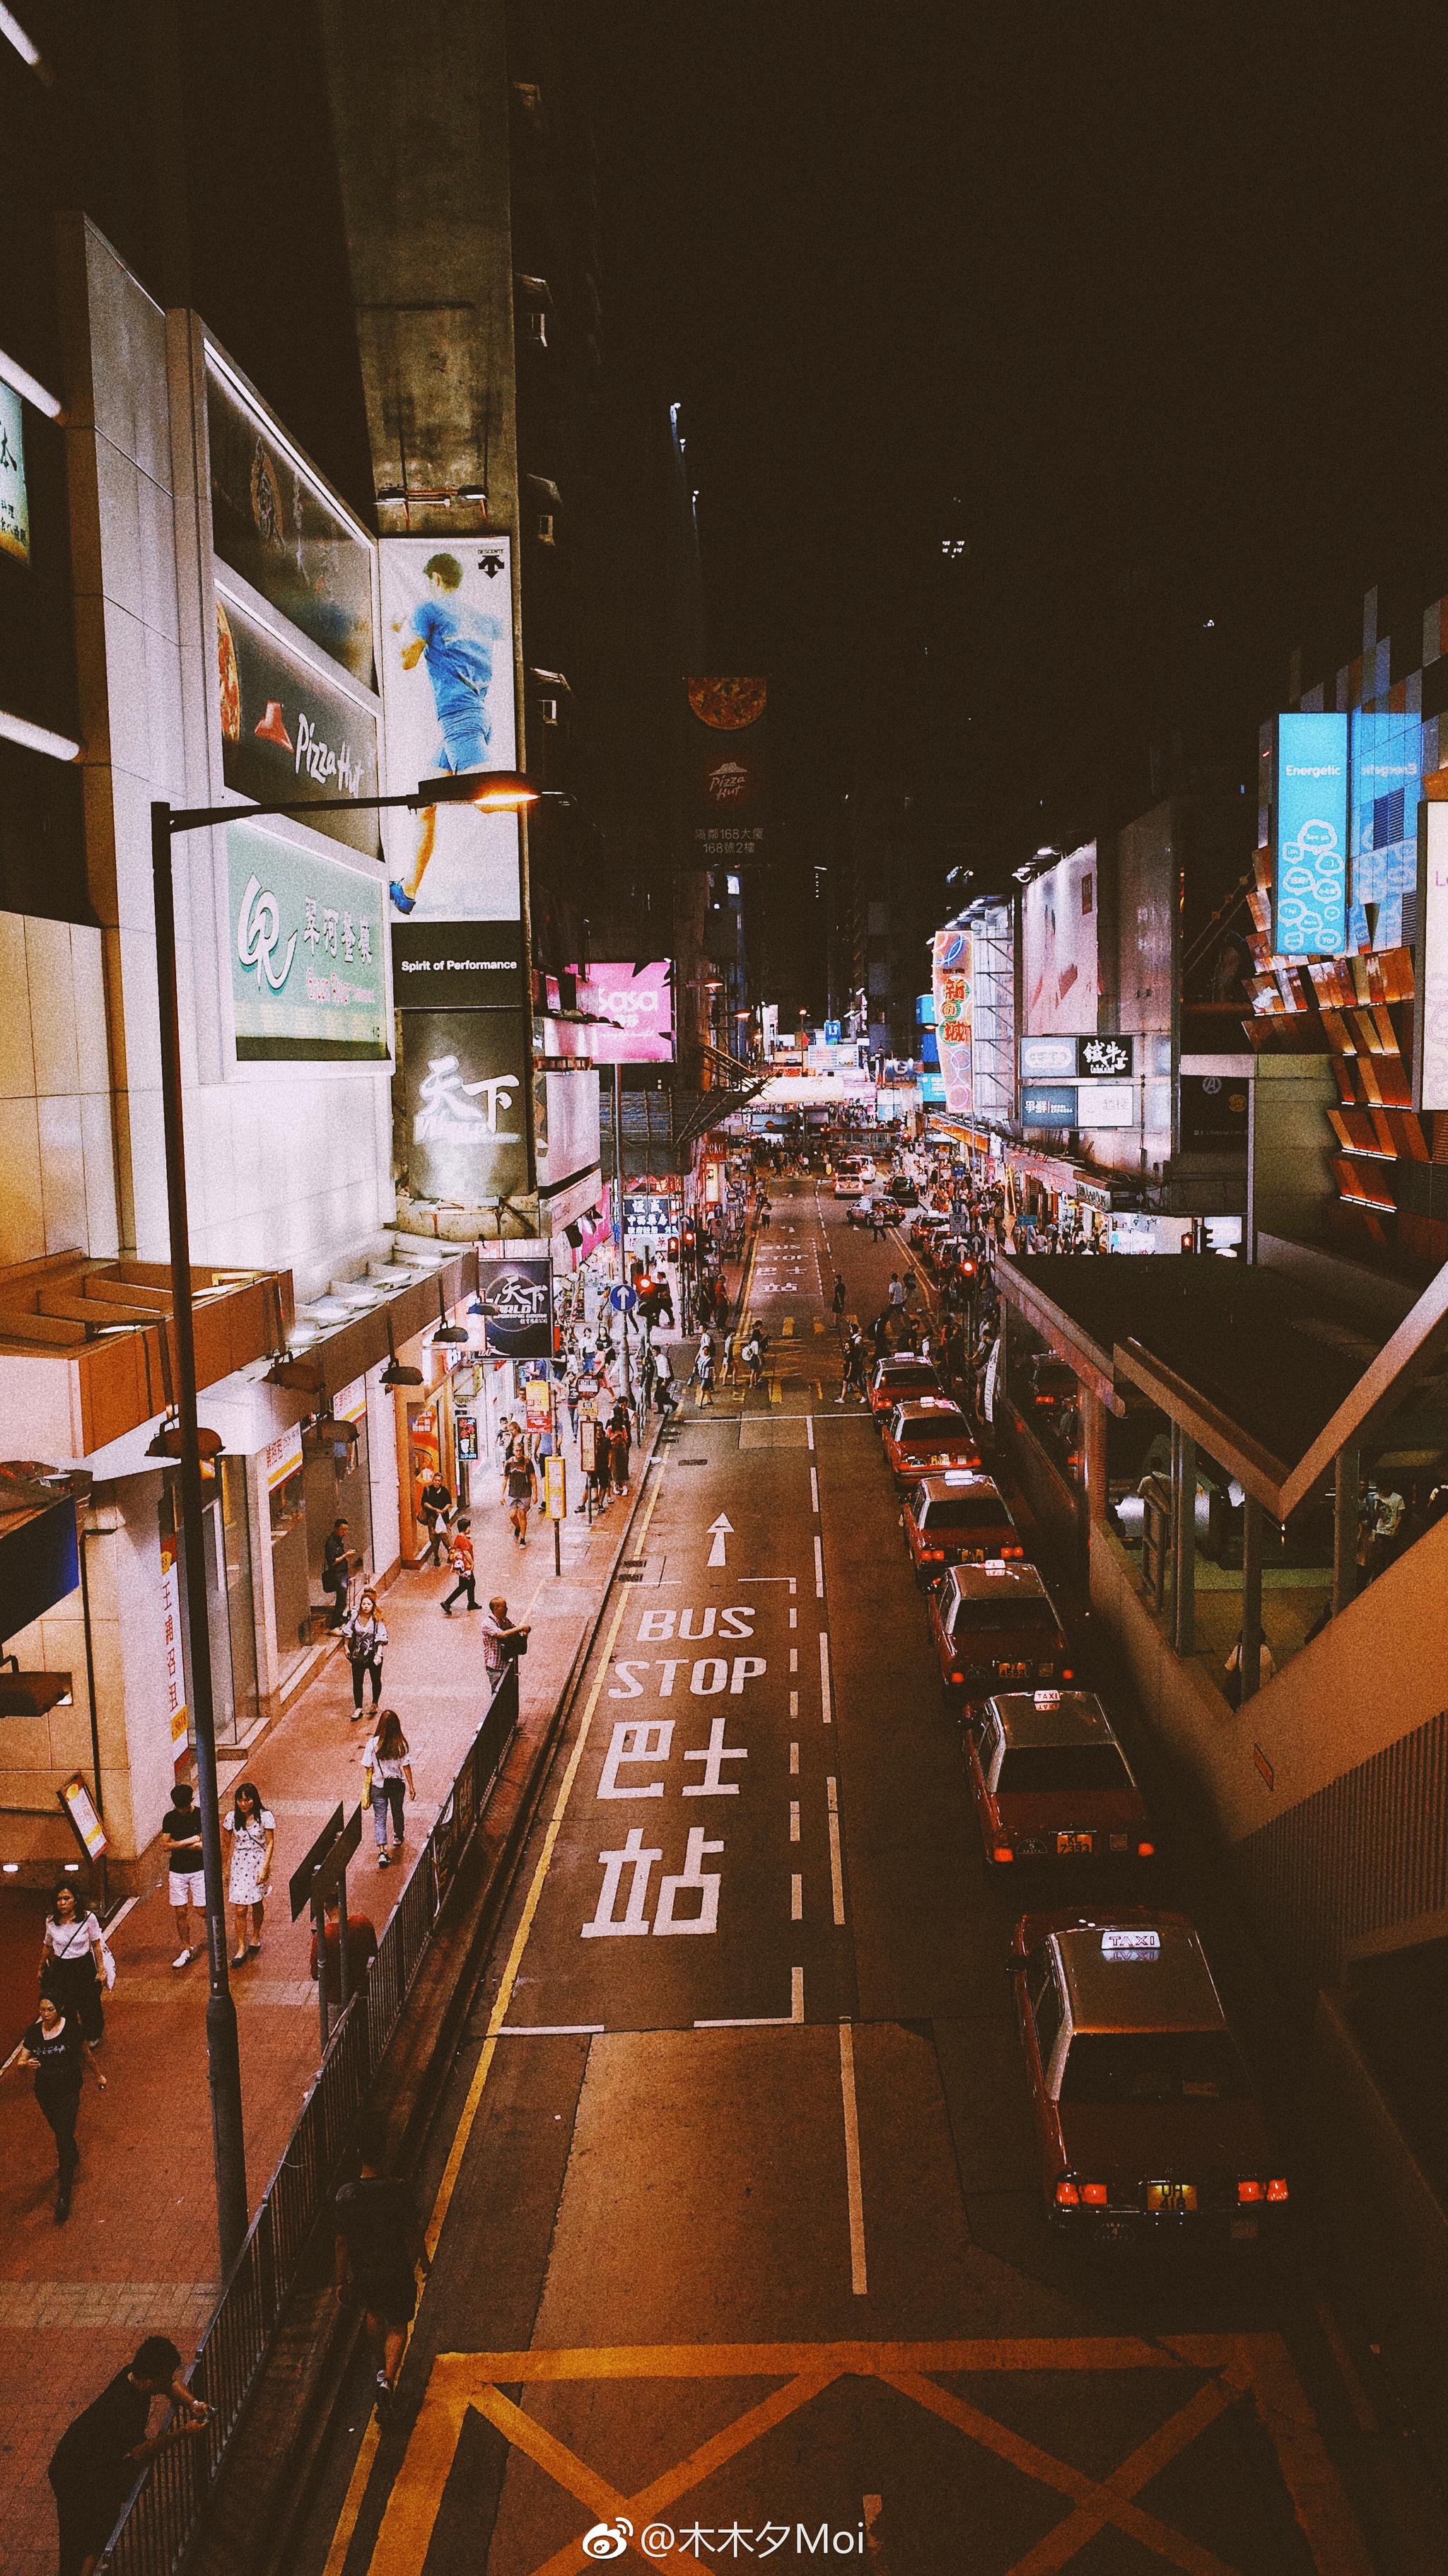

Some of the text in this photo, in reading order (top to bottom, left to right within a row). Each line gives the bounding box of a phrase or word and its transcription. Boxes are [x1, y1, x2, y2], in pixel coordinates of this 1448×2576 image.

[296, 713, 365, 800] Pizza Hut
[709, 775, 747, 792] Pizza
[1285, 764, 1342, 778] Energetic
[716, 785, 748, 801] Hut
[401, 959, 518, 973] Spirit of Performance
[419, 1054, 520, 1135] 天下
[755, 1266, 807, 1277] 巴士
[501, 1275, 549, 1314] 天下
[759, 1282, 798, 1293] 站
[635, 1605, 757, 1642] BUS
[607, 1656, 767, 1700] STOP
[596, 1717, 749, 1800] 巴士
[580, 1826, 725, 1938] 站
[1109, 1936, 1155, 1946] TAXI
